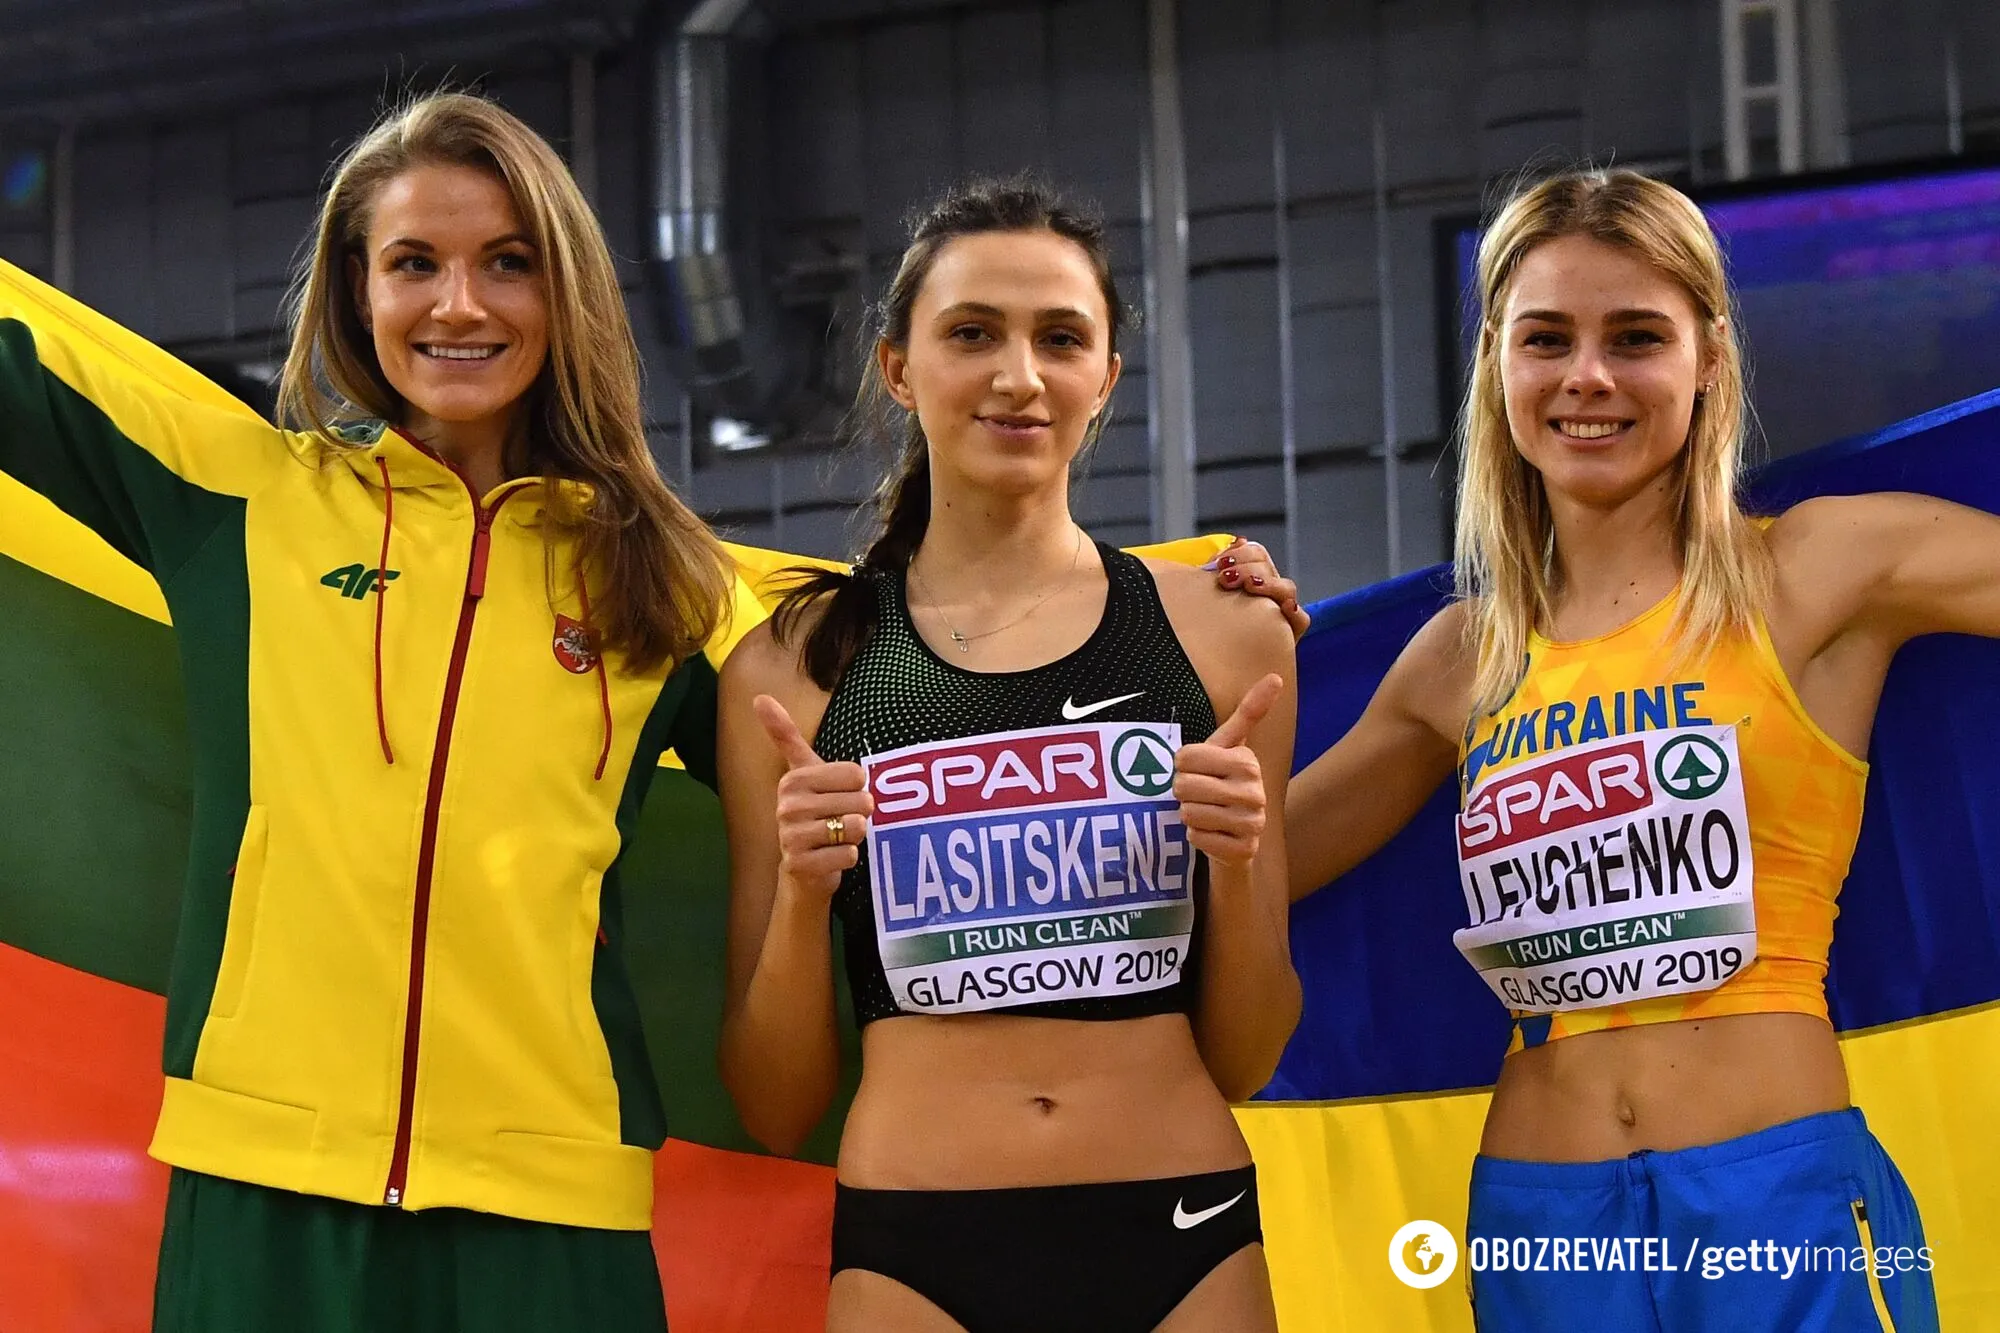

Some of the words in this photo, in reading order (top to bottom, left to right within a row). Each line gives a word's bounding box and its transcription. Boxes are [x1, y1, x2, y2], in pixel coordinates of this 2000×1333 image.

[1485, 682, 1712, 767] UKRAINE
[875, 742, 1099, 813] SPAR
[1462, 753, 1646, 847] SPAR
[881, 810, 1184, 921] LASITSKENE
[948, 933, 957, 955] I
[964, 924, 1028, 953] RUN
[1506, 942, 1515, 964] I
[1522, 934, 1572, 960] RUN
[907, 955, 1103, 1007] GLASGOW
[1115, 946, 1178, 985] 2019
[1500, 958, 1644, 1006] GLASGOW
[1655, 946, 1742, 987] 2019
